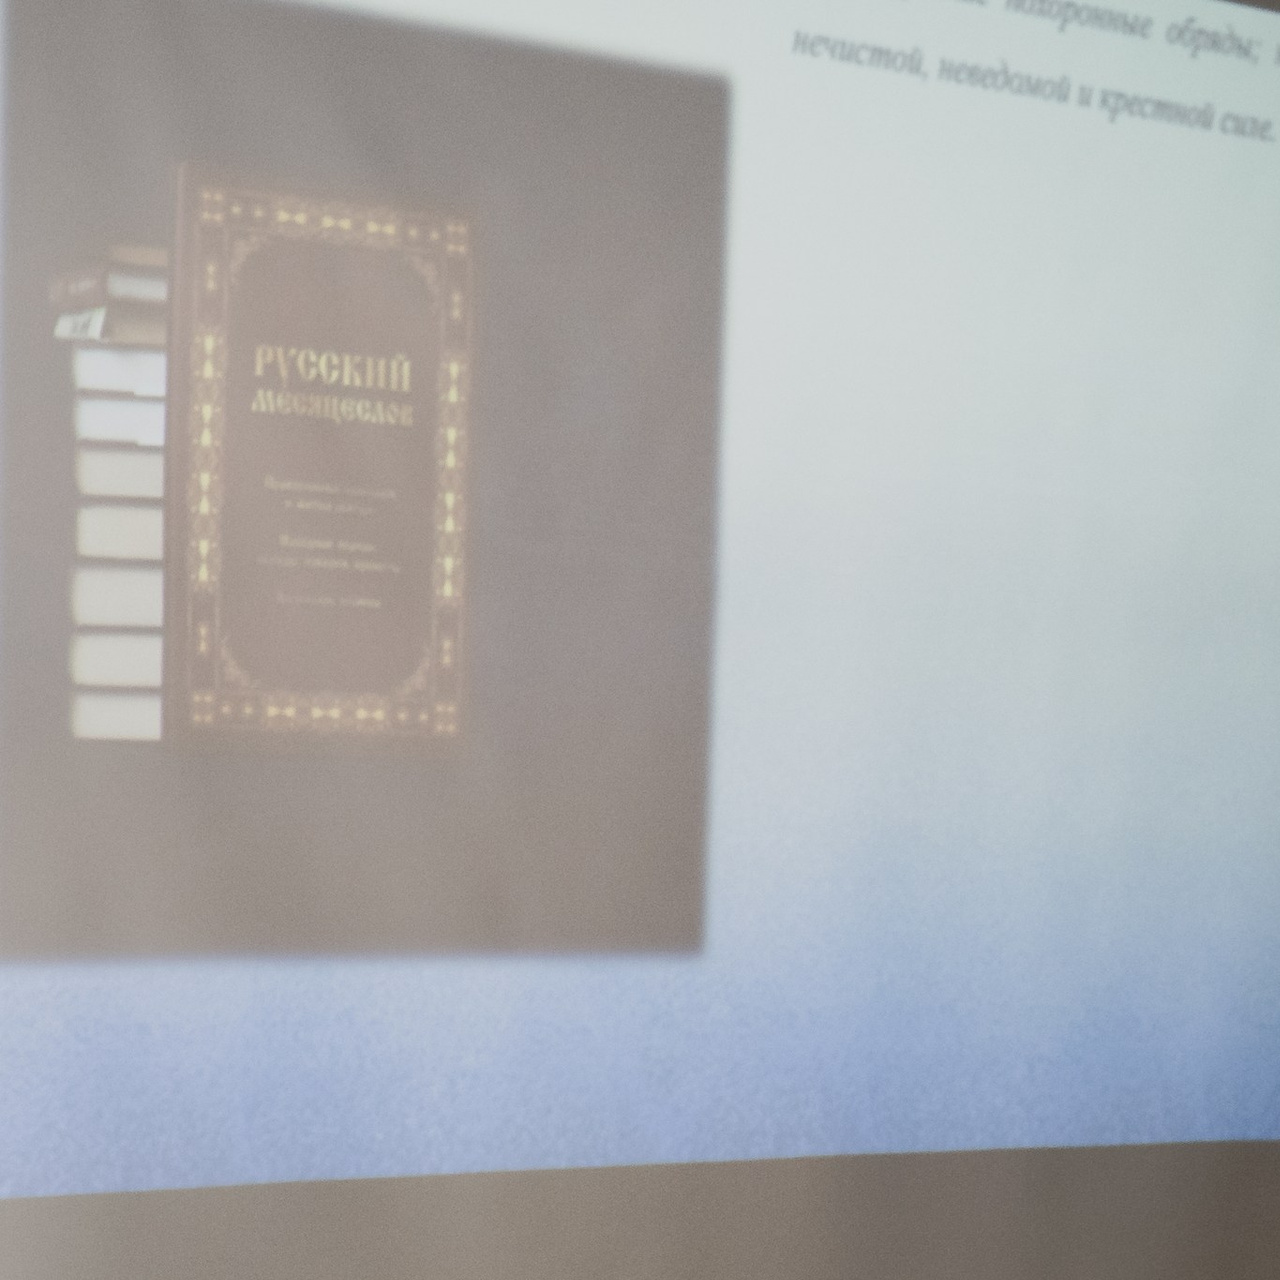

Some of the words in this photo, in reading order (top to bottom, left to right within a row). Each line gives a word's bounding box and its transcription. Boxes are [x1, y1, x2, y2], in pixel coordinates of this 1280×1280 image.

[792, 30, 928, 80] нечистой,
[937, 58, 1071, 104] неведомой
[1077, 85, 1094, 107] и
[1100, 89, 1215, 130] крестной
